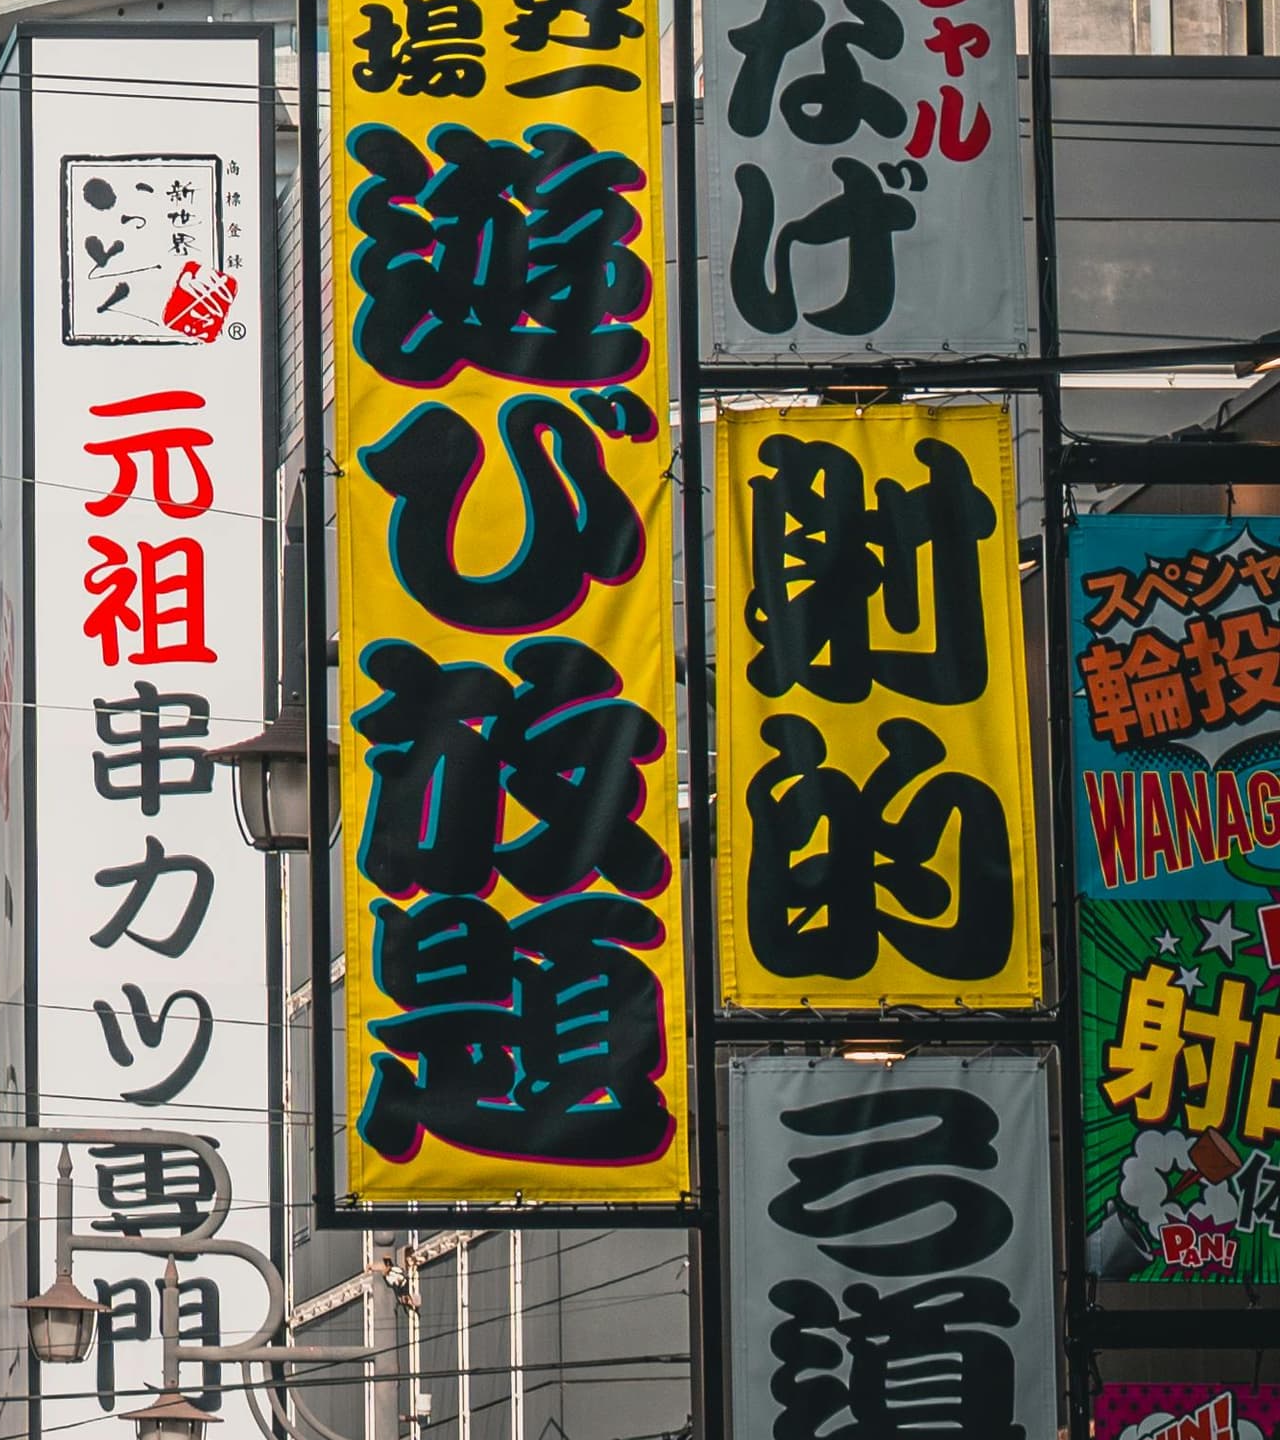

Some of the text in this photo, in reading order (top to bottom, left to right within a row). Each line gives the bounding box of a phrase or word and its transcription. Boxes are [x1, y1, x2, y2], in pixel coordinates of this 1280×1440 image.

[346, 123, 678, 1168] 遊び放題
[745, 433, 1017, 982] 射的
[1162, 1222, 1238, 1271] PAN!
